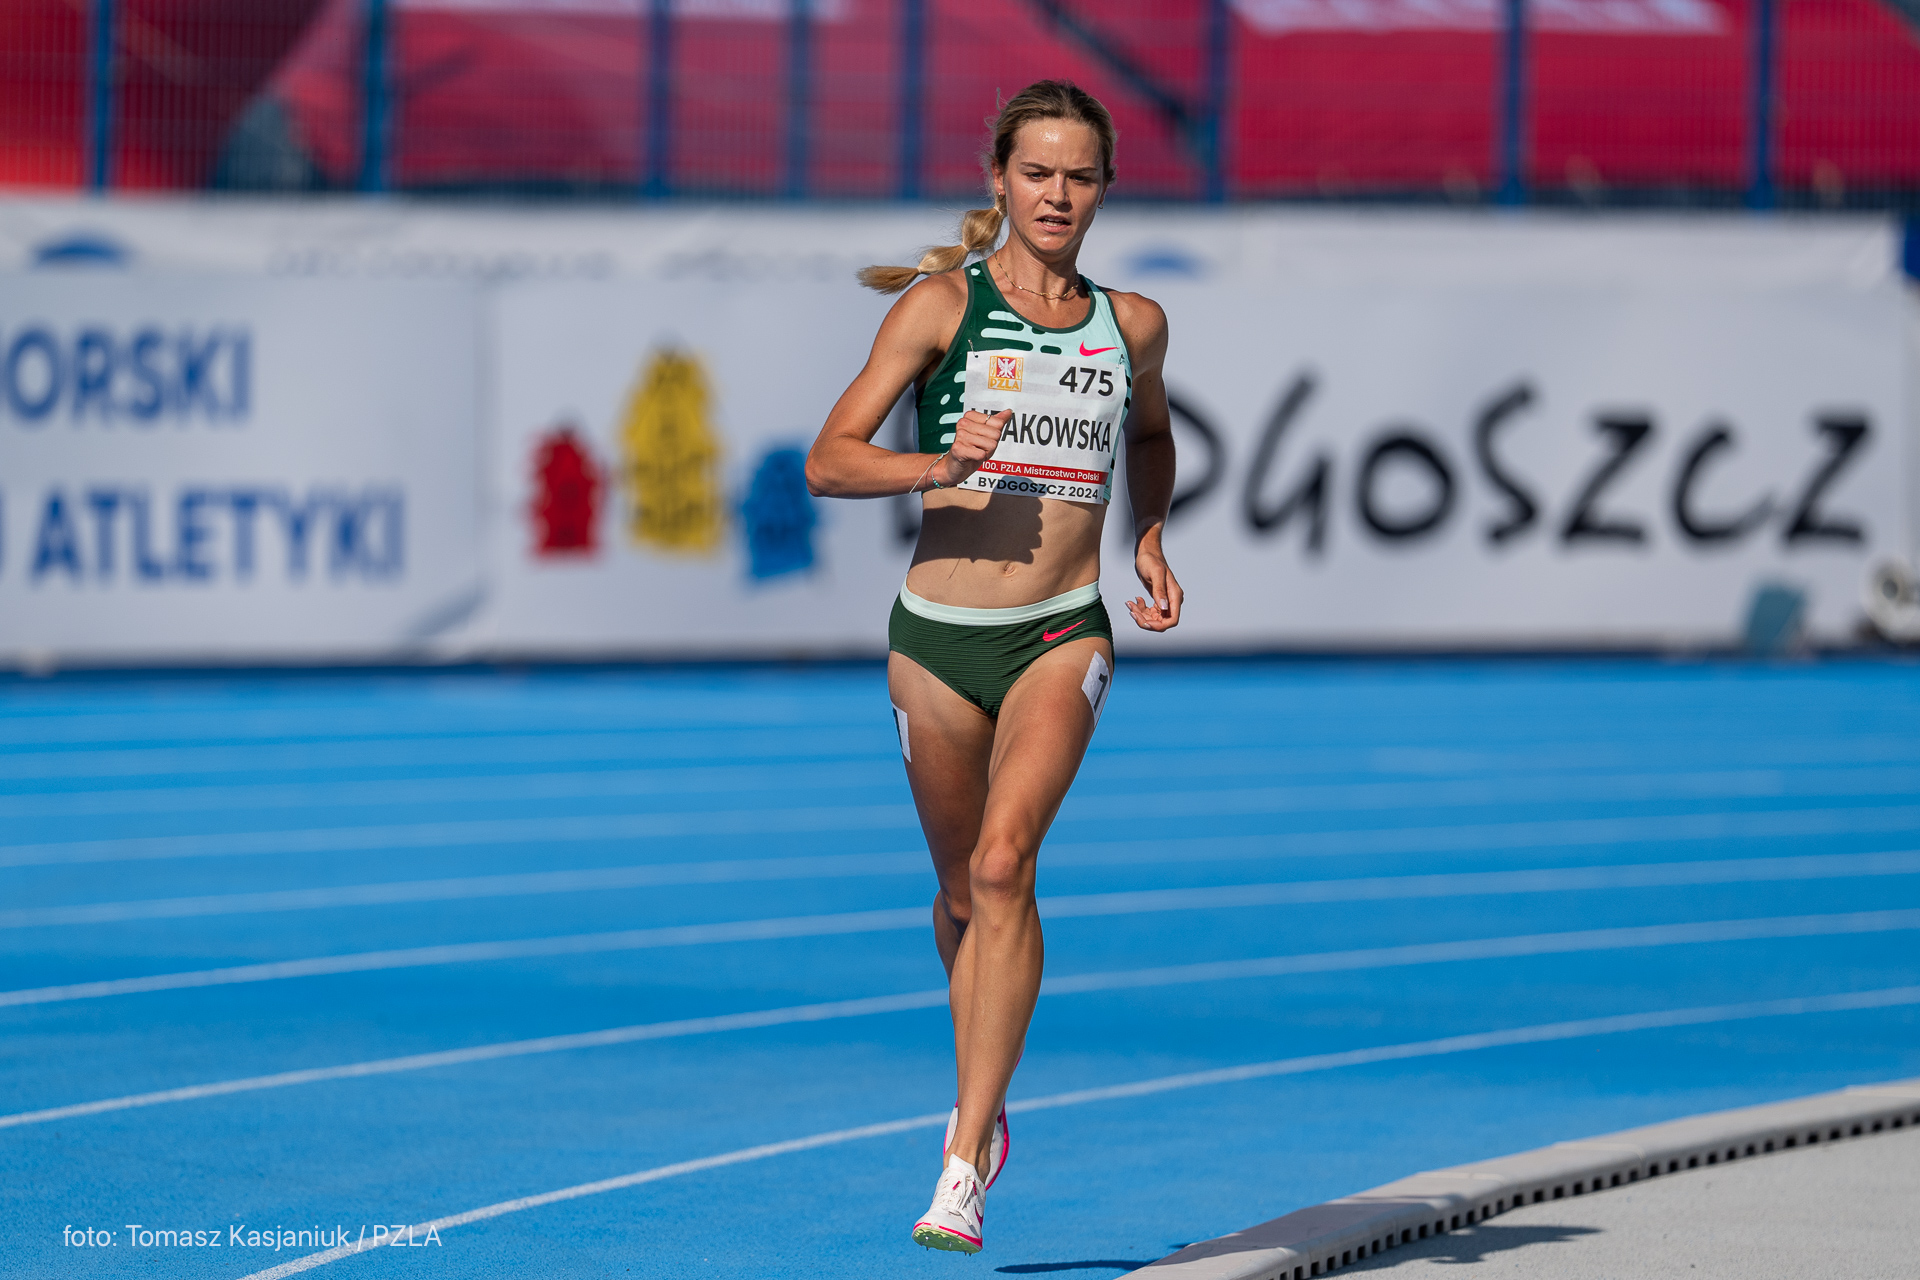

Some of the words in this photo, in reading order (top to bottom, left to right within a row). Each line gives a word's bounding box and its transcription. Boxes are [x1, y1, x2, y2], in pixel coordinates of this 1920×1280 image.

[990, 378, 1020, 390] PZLA
[1059, 366, 1114, 396] 475
[971, 408, 1111, 453] AKOWSKA
[982, 461, 999, 471] 100.
[1000, 463, 1021, 474] PZLA
[1023, 466, 1076, 479] Mistrzostwa
[1077, 471, 1100, 482] Polski
[978, 477, 1066, 496] BYDGOSZCZ
[1068, 486, 1098, 500] 2024
[28, 484, 408, 586] ATLETYKI
